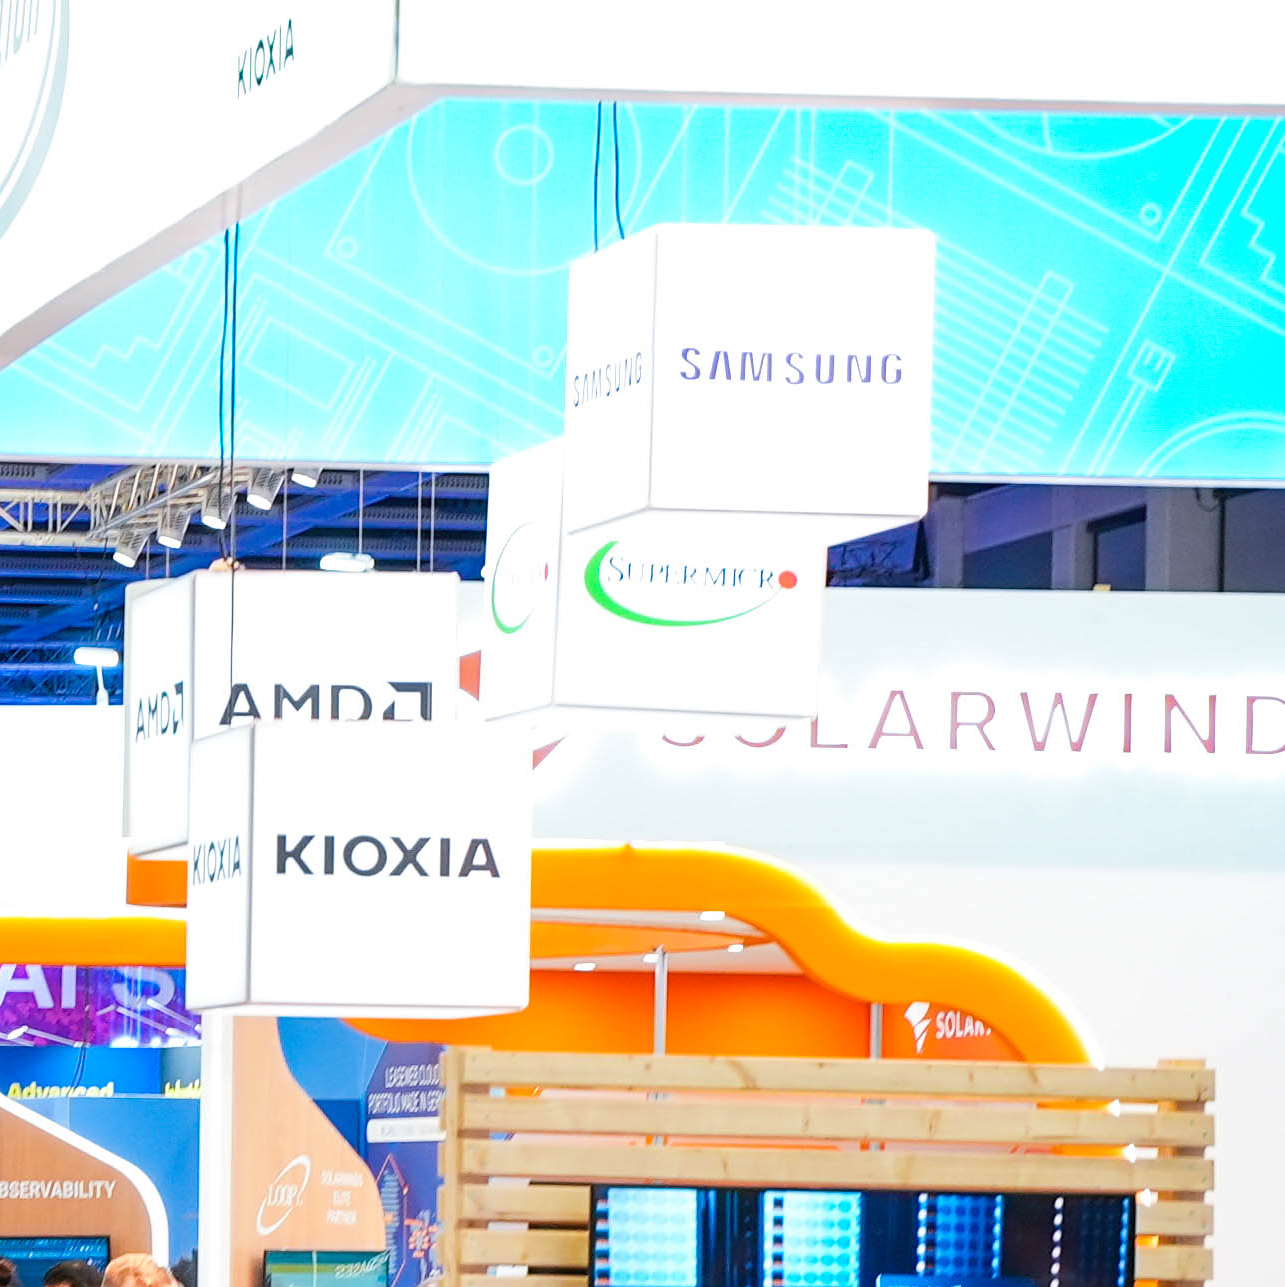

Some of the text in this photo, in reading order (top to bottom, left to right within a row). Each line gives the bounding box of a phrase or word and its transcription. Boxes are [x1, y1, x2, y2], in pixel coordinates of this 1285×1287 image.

[237, 18, 295, 99] KIOXIA
[574, 352, 642, 408] SAMSUNG
[680, 347, 903, 384] SAMSUNG
[135, 690, 171, 743] AMD
[219, 682, 373, 725] AMD
[662, 690, 1285, 755] LARWIND
[193, 835, 241, 886] KIOXIA
[276, 834, 501, 878] KIOXIA
[936, 1011, 991, 1039] SOLA
